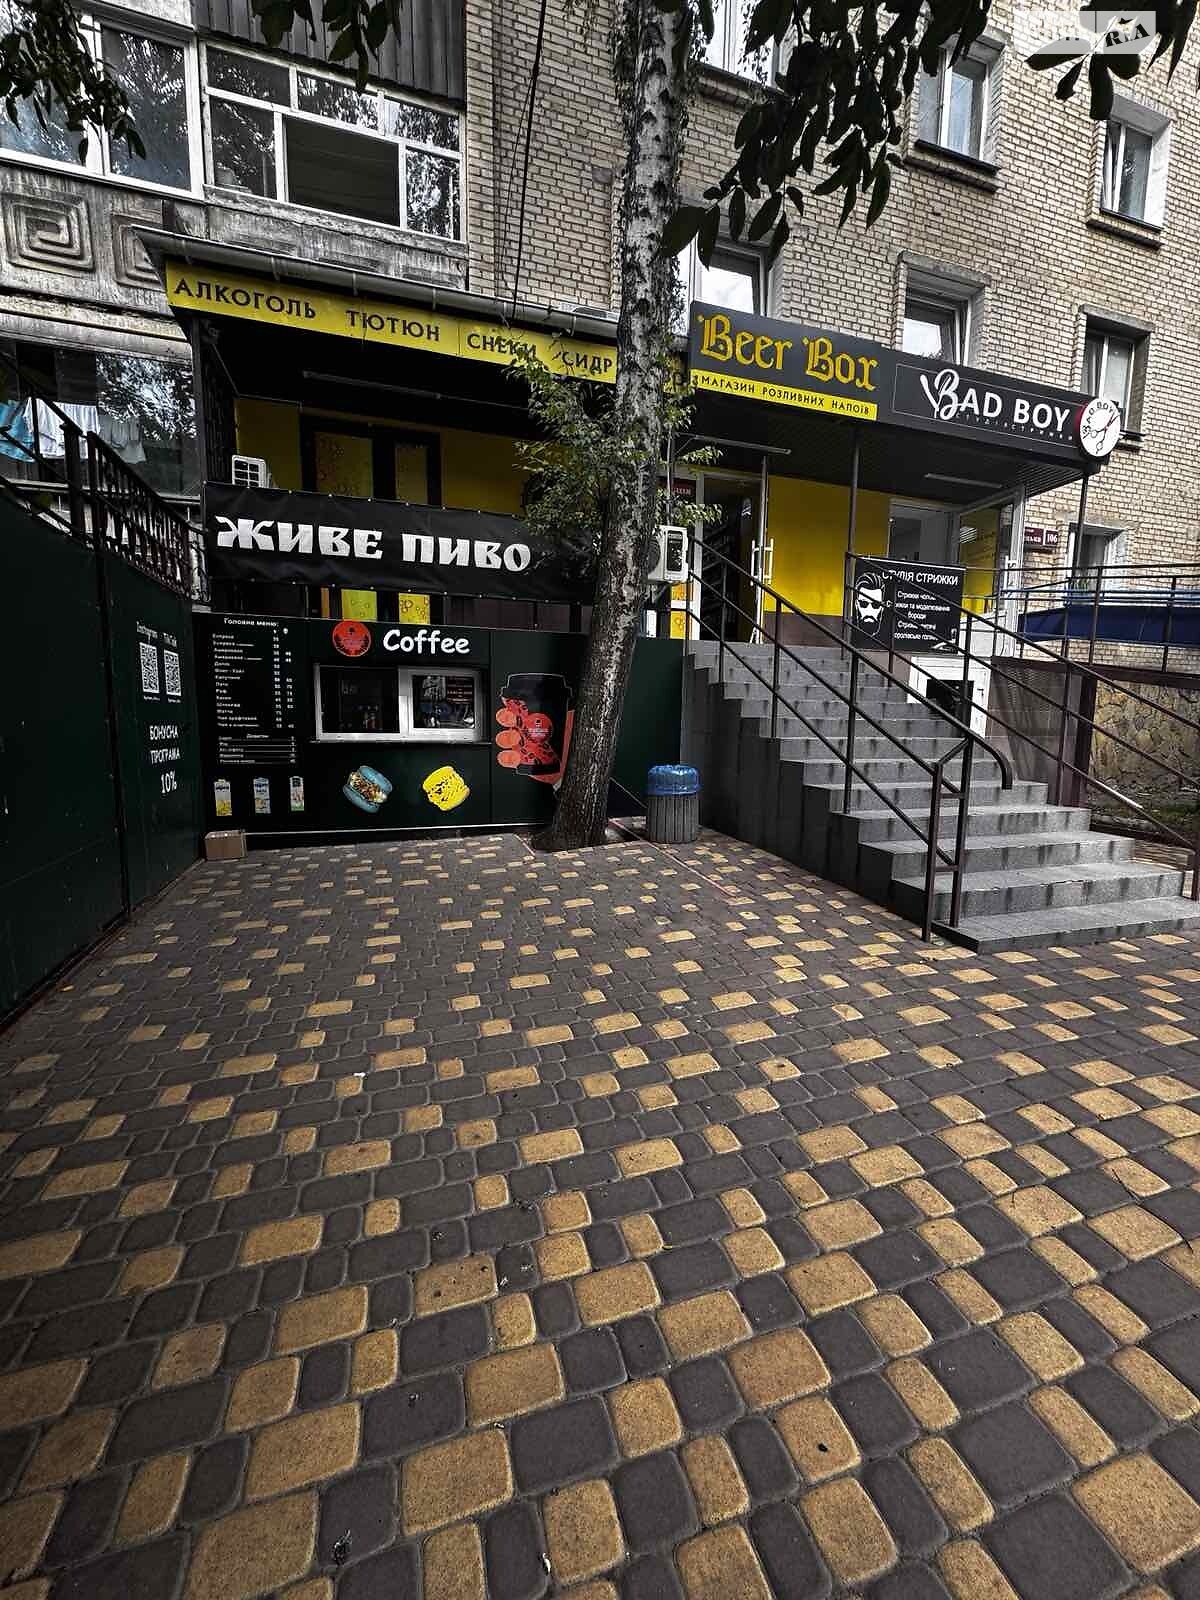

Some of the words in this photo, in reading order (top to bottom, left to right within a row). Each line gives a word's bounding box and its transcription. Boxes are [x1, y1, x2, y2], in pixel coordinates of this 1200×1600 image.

[174, 277, 316, 319] АЛКОГОЛЬ
[345, 309, 440, 342] ТЮТЮН
[561, 350, 613, 374] СИДР
[697, 314, 793, 370] Beer
[803, 337, 879, 391] Box
[701, 376, 755, 393] МАГАЗИН
[762, 386, 825, 406] РОЗЛИВНИХ
[919, 368, 1002, 420] BAD
[1013, 398, 1071, 432] BOY
[215, 515, 383, 559] ЖИВЕ
[401, 533, 531, 572] ПИВО
[1047, 533, 1058, 543] 106
[916, 572, 958, 585] СТРИЖКИ
[382, 629, 471, 655] Coffee
[149, 724, 179, 741] БОНУСНА
[150, 747, 181, 764] ПРОГРАМА
[161, 770, 178, 794] 10%
